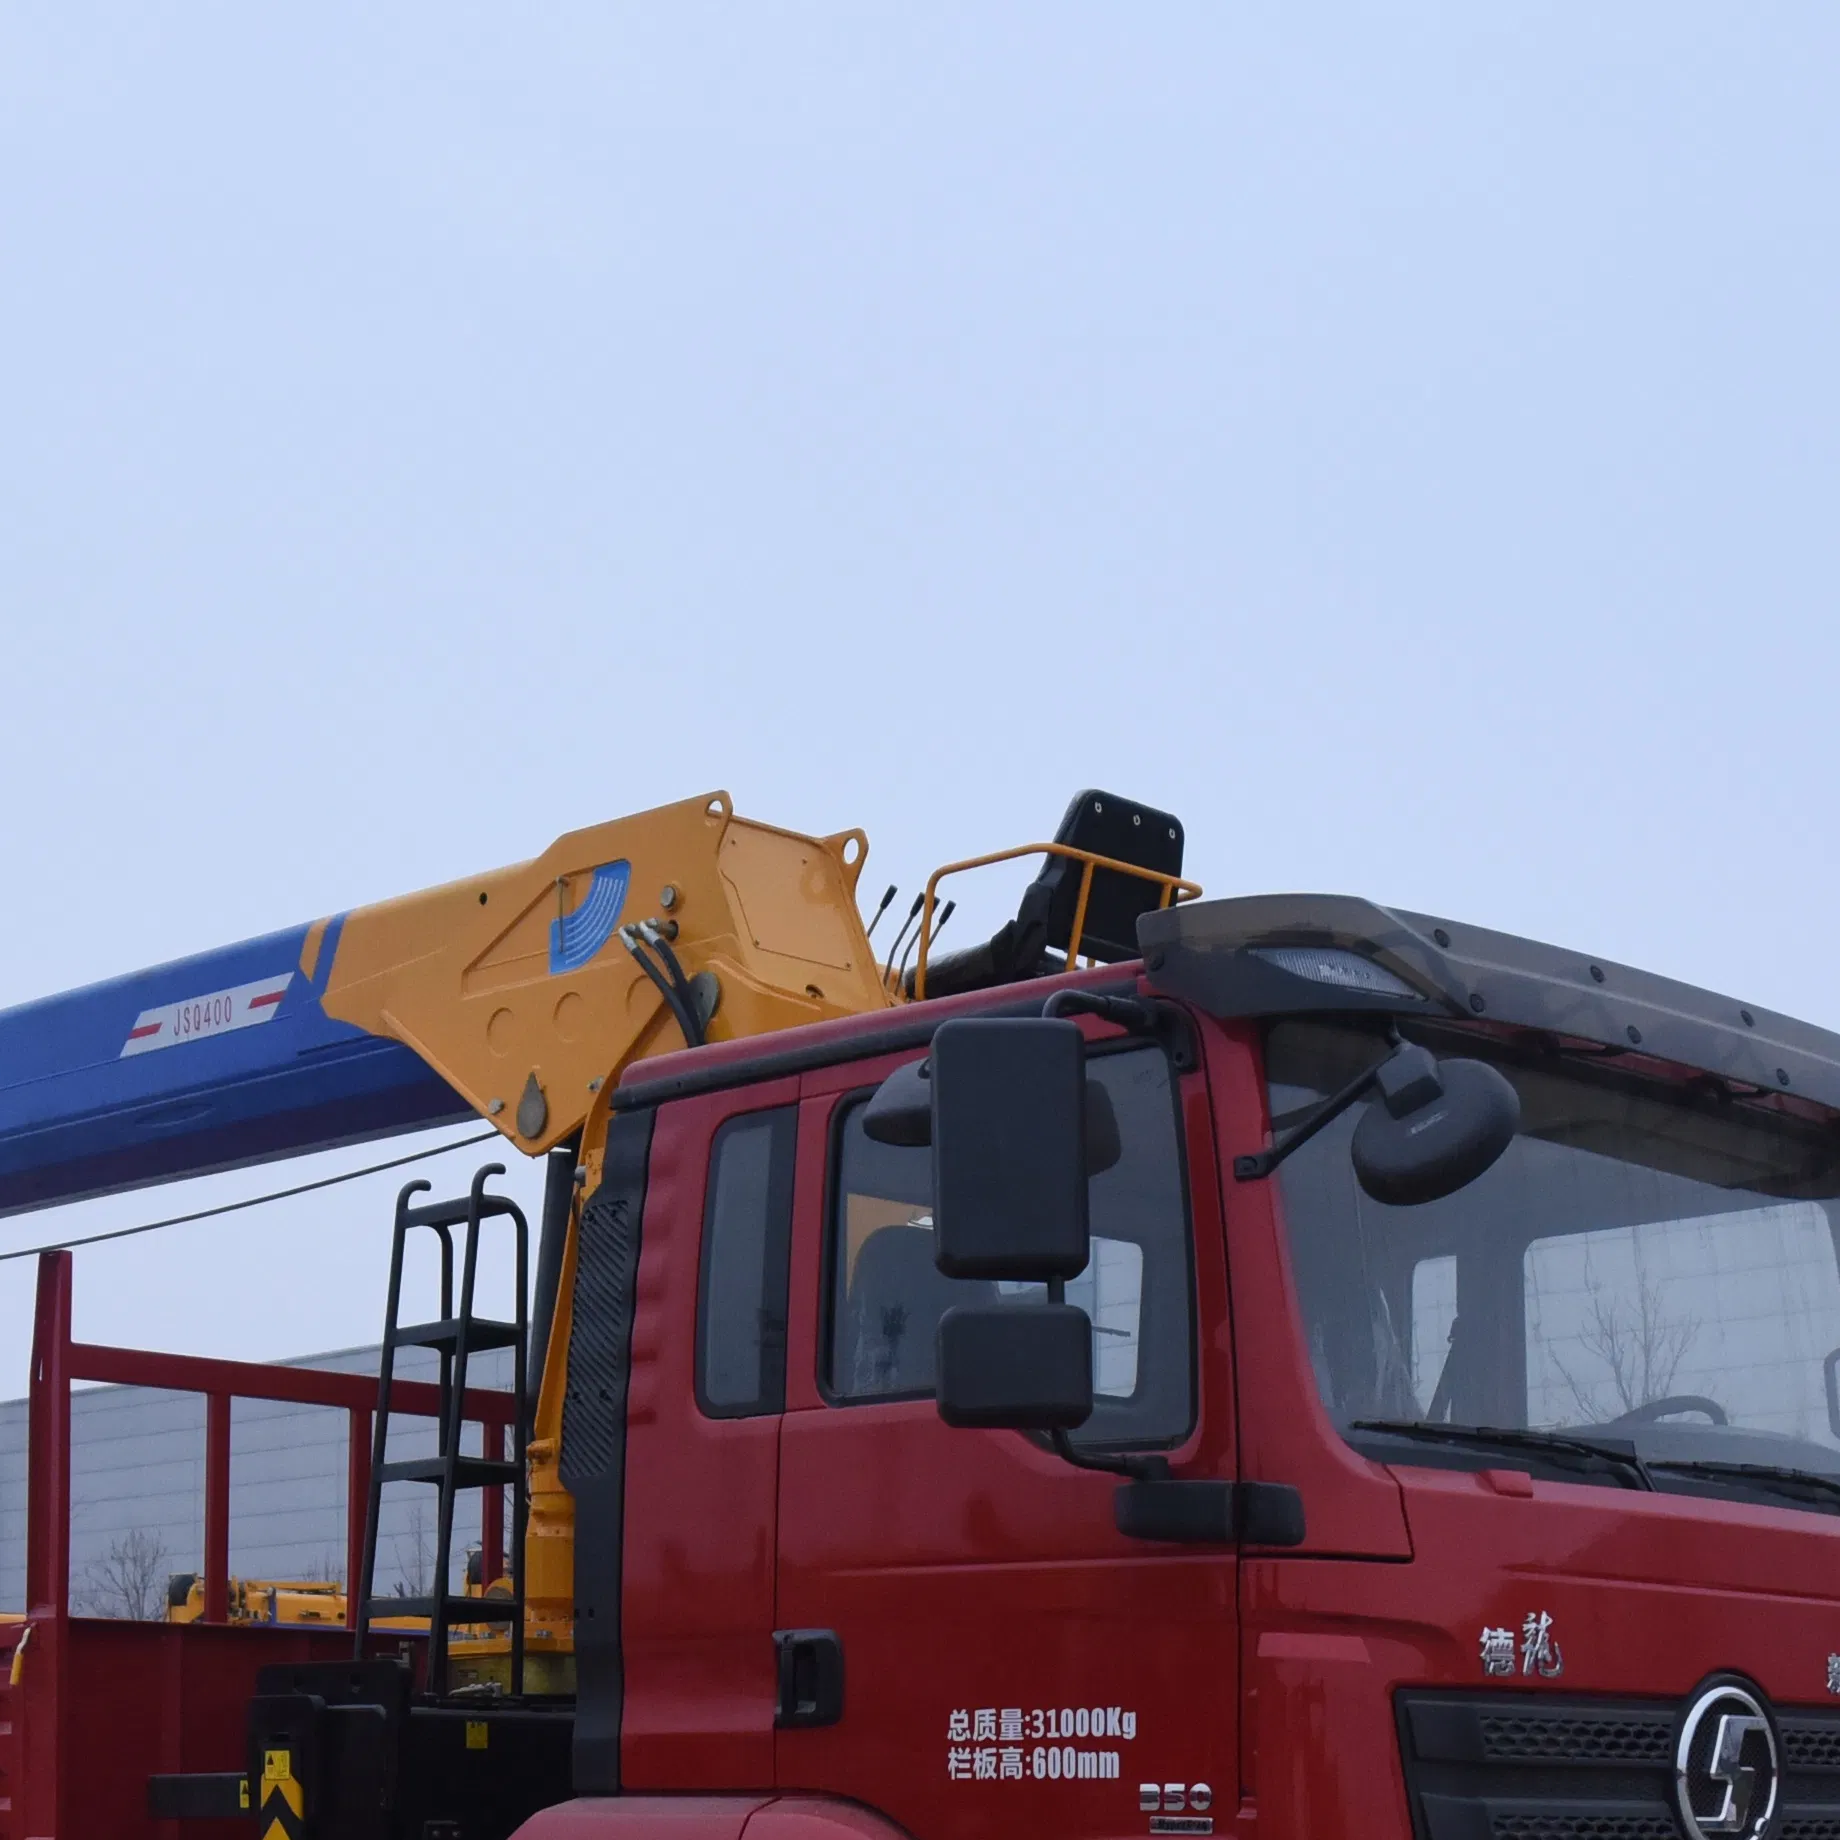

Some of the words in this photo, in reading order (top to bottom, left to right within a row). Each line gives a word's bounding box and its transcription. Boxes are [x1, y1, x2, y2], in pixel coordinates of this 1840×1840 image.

[173, 995, 233, 1037] JSQ400
[947, 1706, 1137, 1742] 总质量:31000Kg
[947, 1746, 1120, 1780] 栏板高:600mm
[1139, 1783, 1212, 1811] 350
